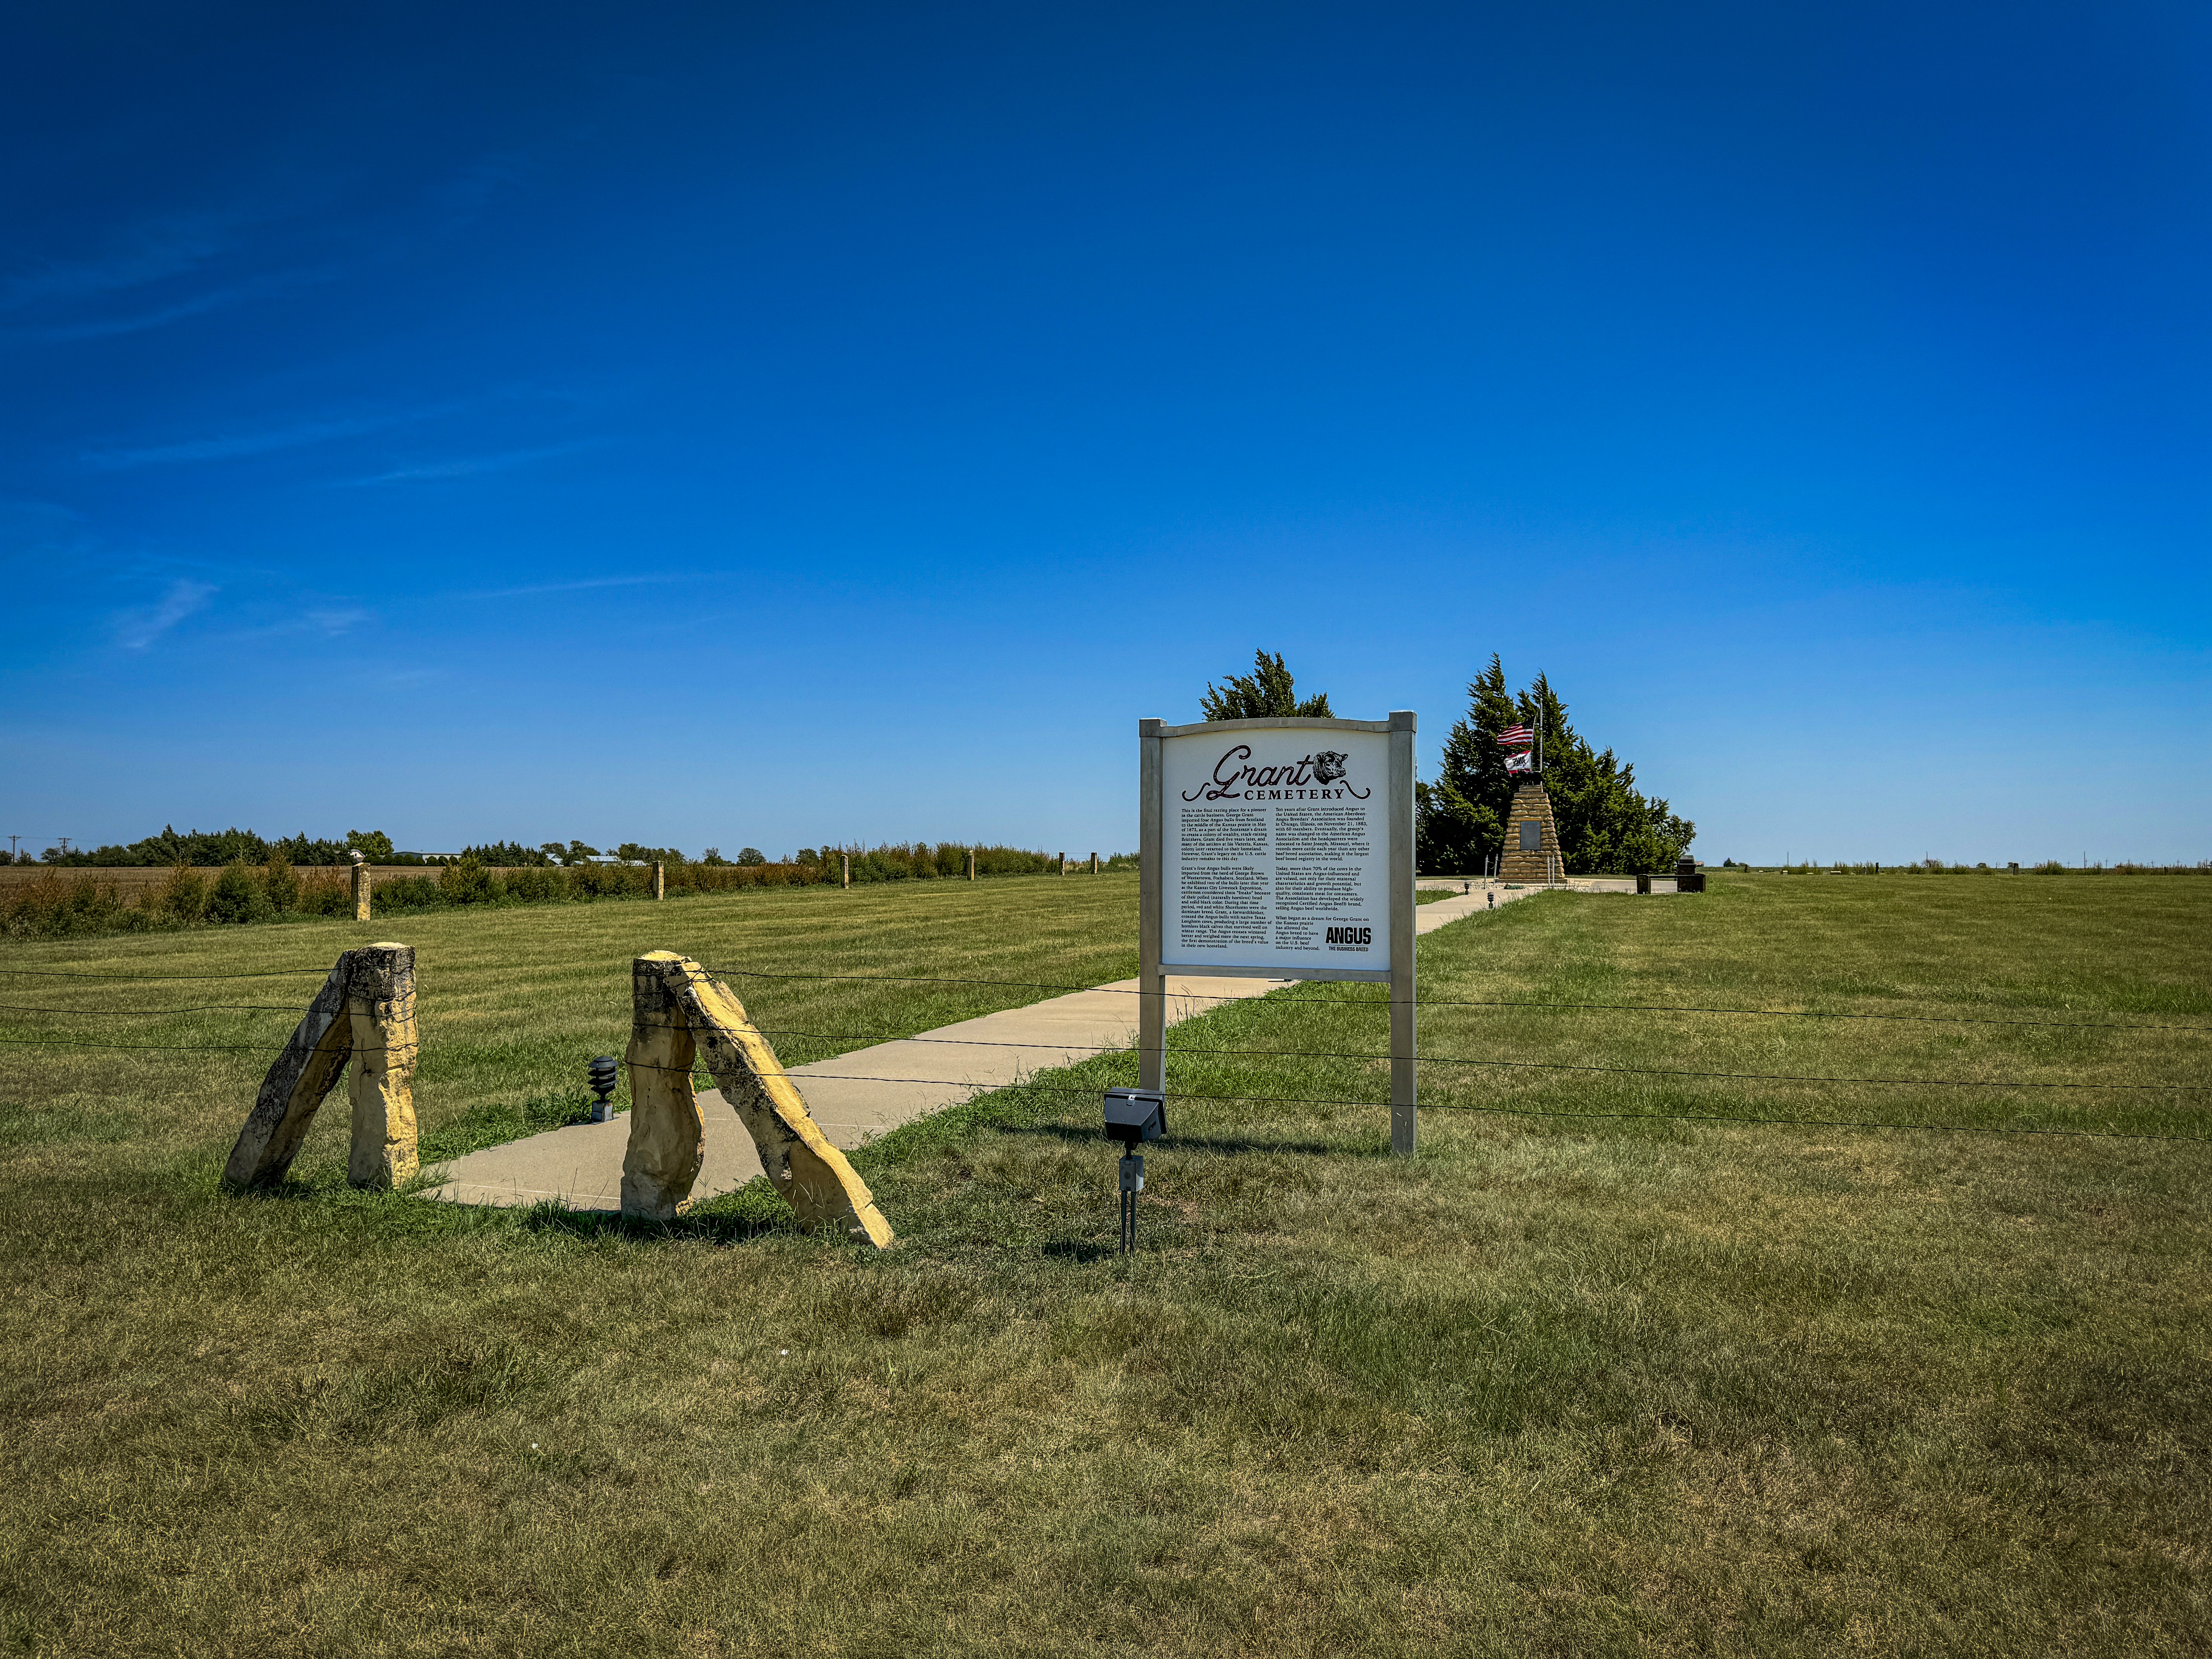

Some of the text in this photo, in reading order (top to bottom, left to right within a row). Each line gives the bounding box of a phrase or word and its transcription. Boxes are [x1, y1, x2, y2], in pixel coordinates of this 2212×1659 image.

[1206, 745, 1314, 801] Grant
[1244, 789, 1344, 800] CEMETERY
[1326, 927, 1371, 945] ANGUS
